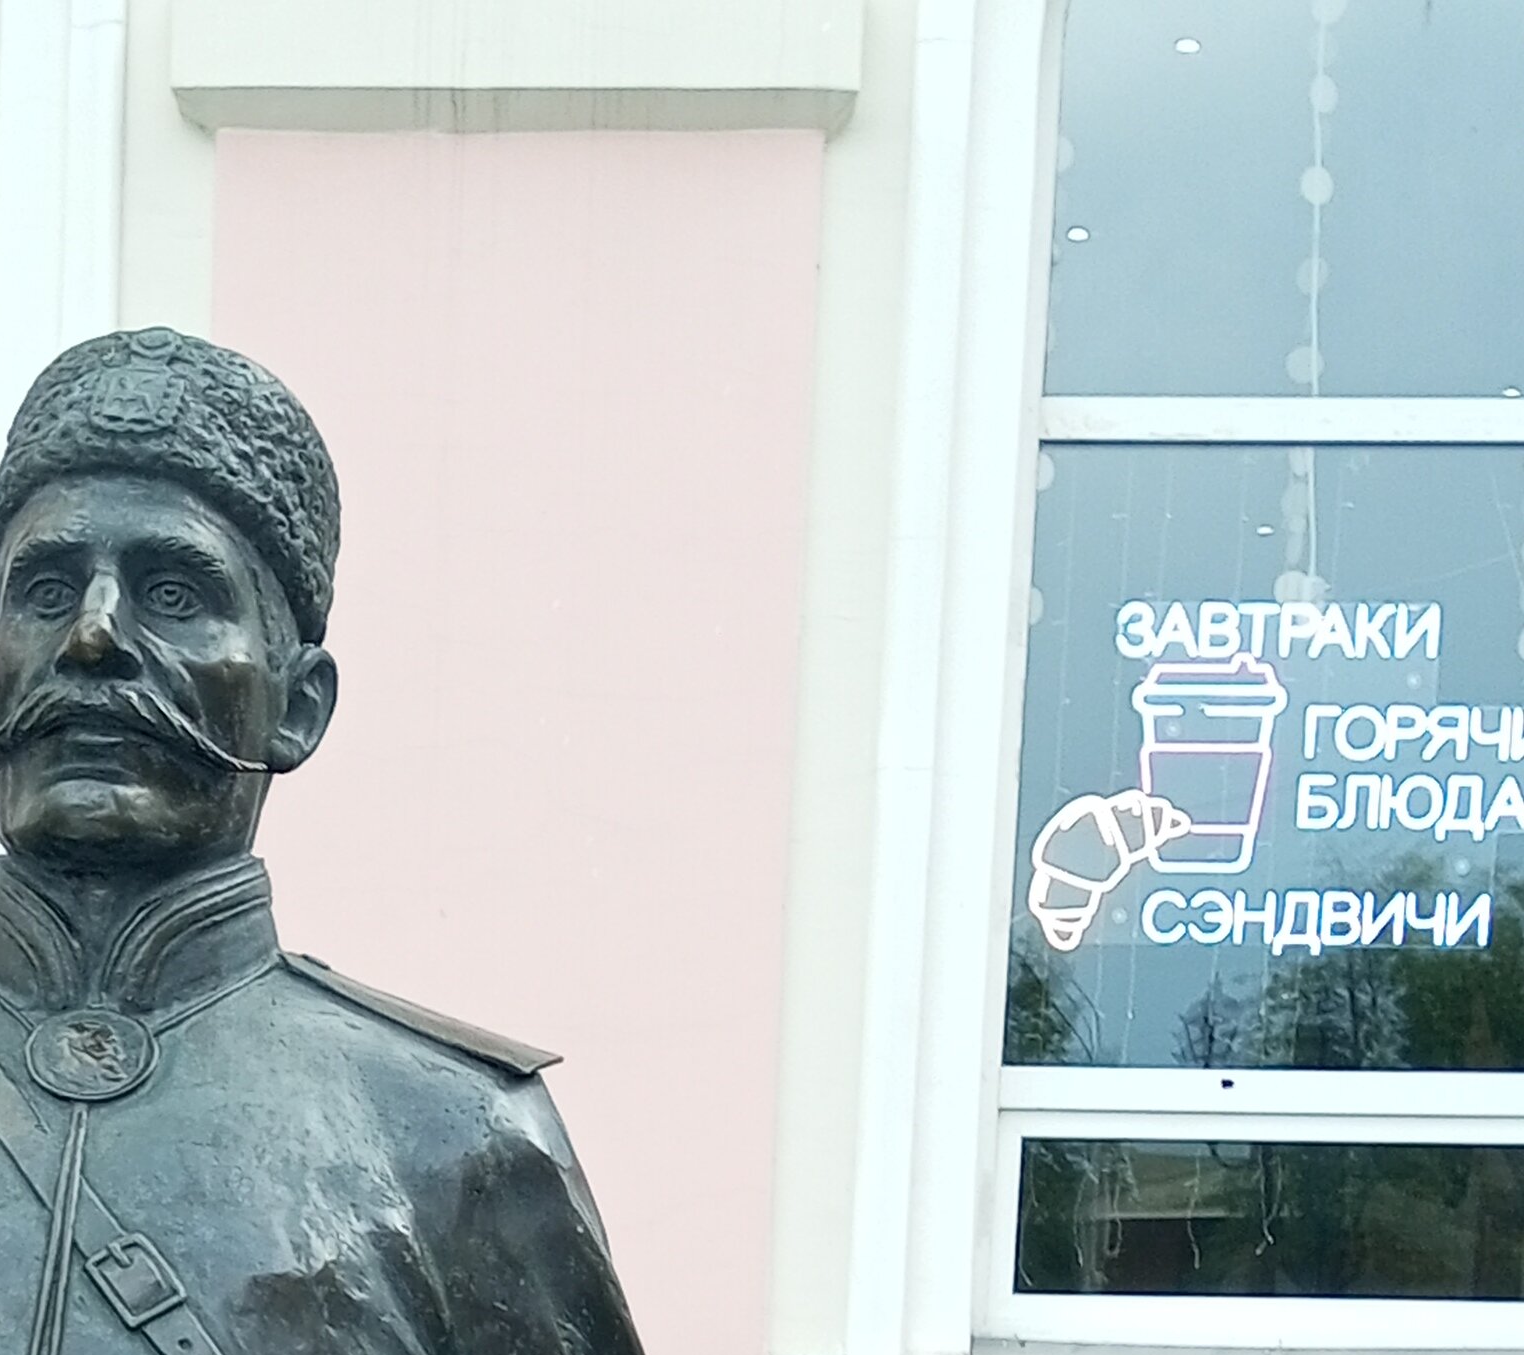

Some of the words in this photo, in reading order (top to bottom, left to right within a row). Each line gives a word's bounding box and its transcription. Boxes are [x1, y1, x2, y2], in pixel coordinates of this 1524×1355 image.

[1114, 600, 1441, 660] ЗАВТРАКИ
[1296, 773, 1524, 842] БЛЮДА
[1141, 889, 1493, 956] СЭНДВИЧИ
